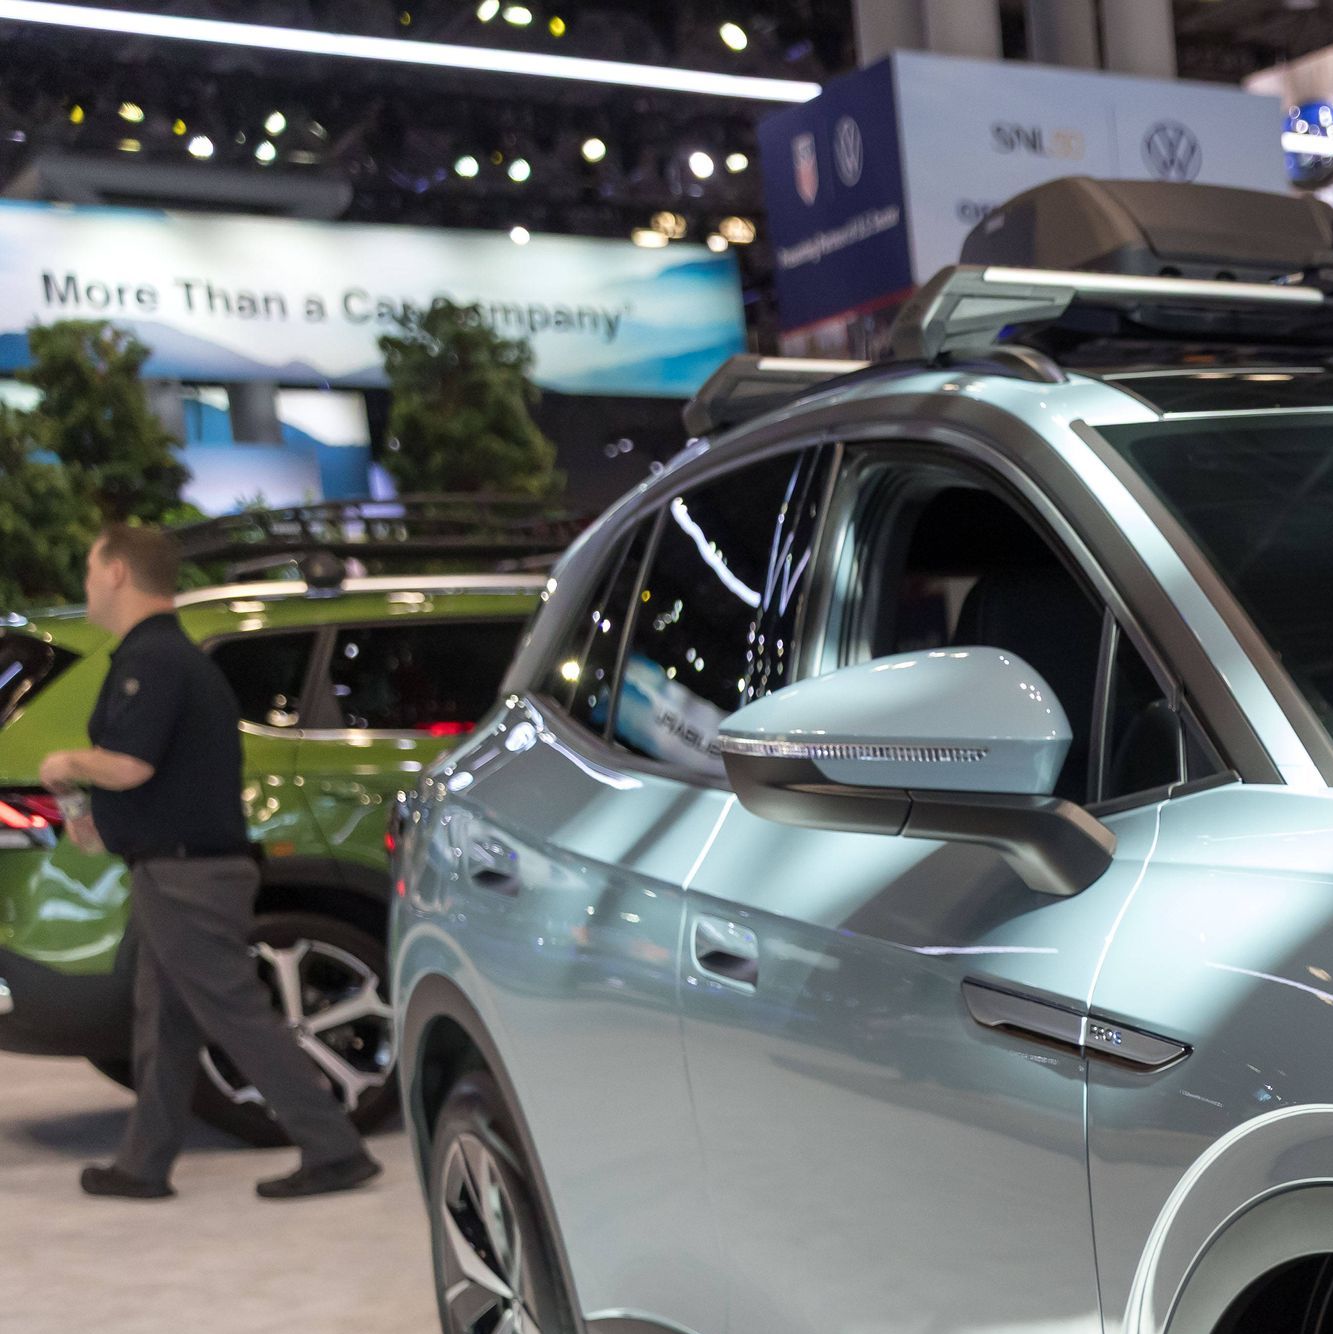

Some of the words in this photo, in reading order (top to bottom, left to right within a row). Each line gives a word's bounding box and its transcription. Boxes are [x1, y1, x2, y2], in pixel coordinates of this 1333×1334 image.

[41, 268, 159, 312] More
[175, 276, 288, 320] Than
[306, 298, 326, 323] a
